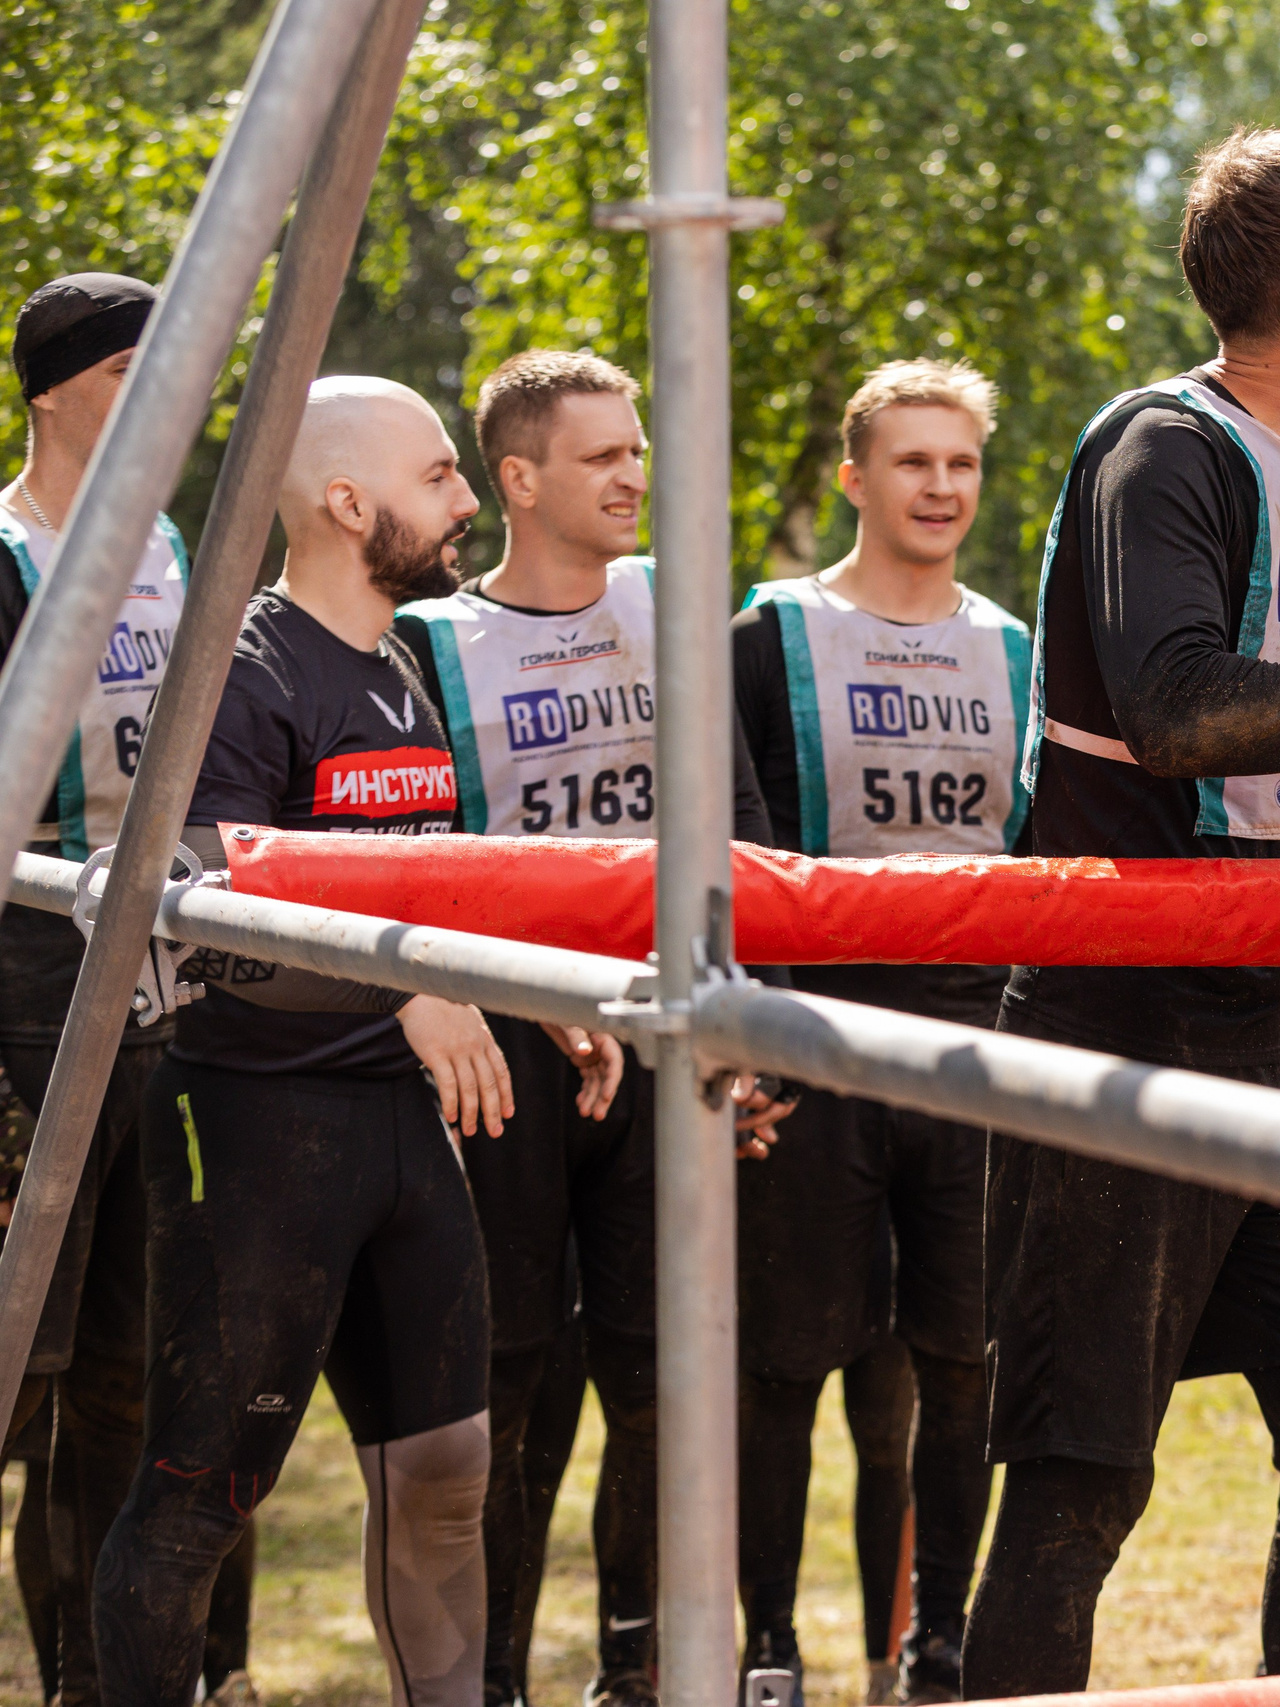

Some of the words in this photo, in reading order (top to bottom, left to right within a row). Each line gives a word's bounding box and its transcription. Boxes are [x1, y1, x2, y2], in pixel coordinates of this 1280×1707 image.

[520, 651, 567, 666] ГОНКА
[570, 640, 617, 659] ГЕРОЕВ
[865, 651, 909, 663] ГОНКА
[508, 683, 654, 744] RODVIG
[852, 691, 991, 735] RODVIG
[521, 764, 655, 833] 5163
[863, 767, 987, 826] 5162
